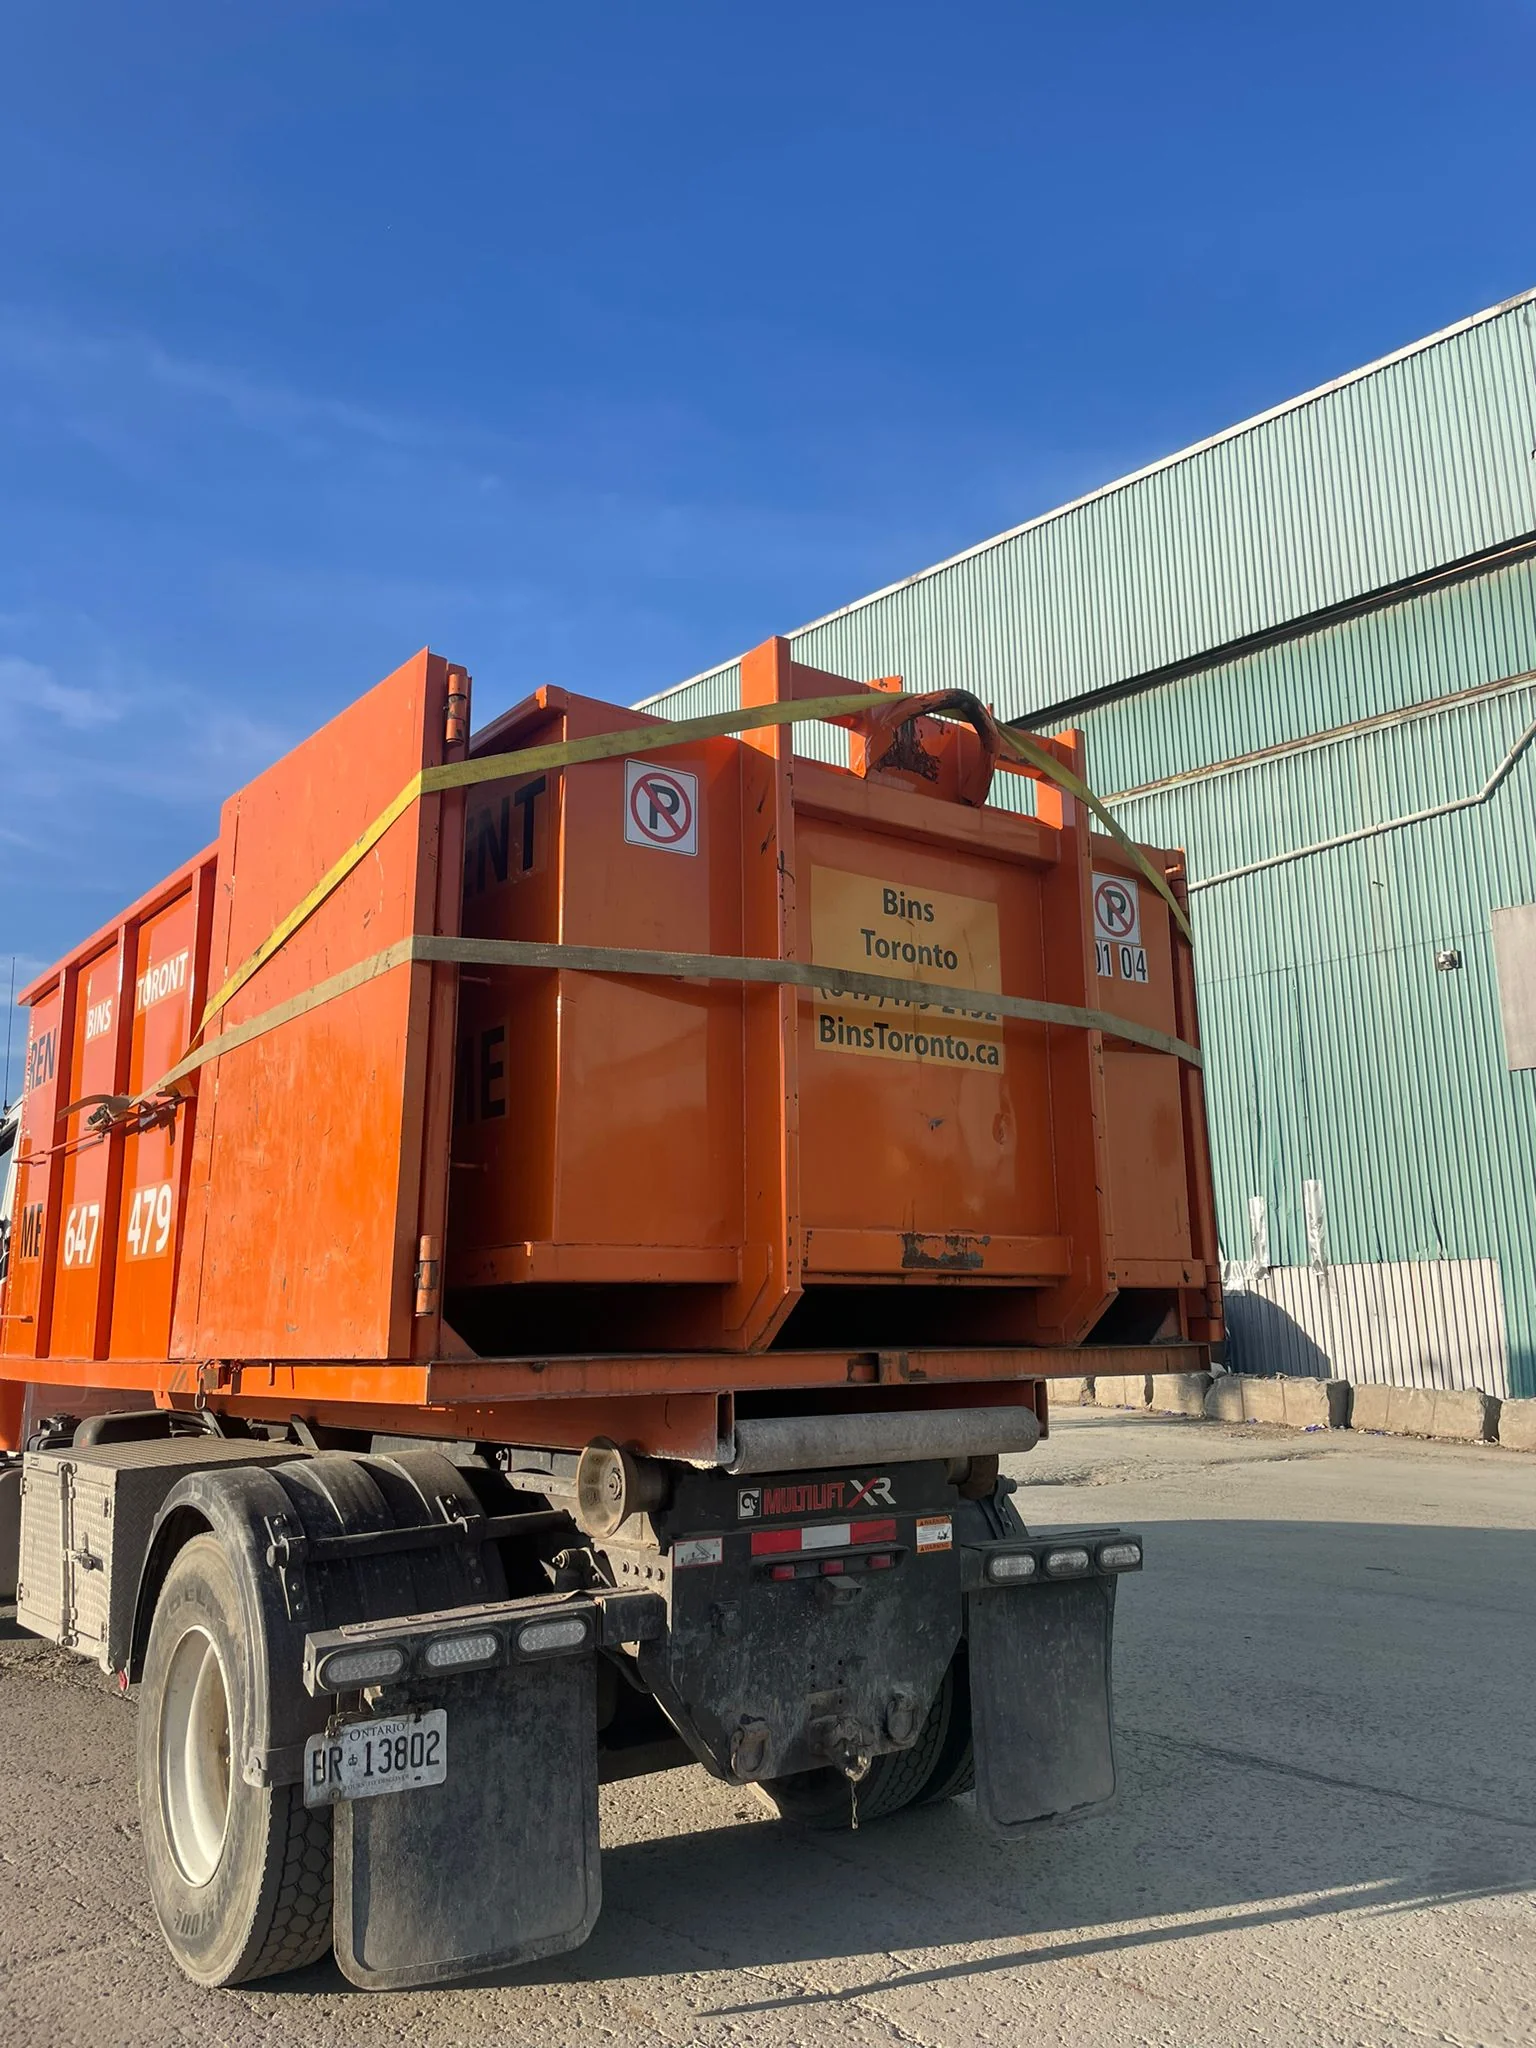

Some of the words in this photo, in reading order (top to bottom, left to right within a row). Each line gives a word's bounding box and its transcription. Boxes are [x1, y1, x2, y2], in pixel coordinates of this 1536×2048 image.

[882, 887, 935, 922] Bins
[860, 928, 959, 970] Toronto
[86, 999, 112, 1040] BINS
[820, 1014, 1000, 1066] BinsToronto.ca
[20, 1203, 43, 1258] ME
[64, 1203, 100, 1267] 647
[127, 1183, 172, 1257] 479
[763, 1482, 845, 1515] MULTILIFT
[847, 1476, 897, 1508] XR
[349, 1722, 407, 1742] ONTARIO
[363, 1730, 440, 1777] 13802
